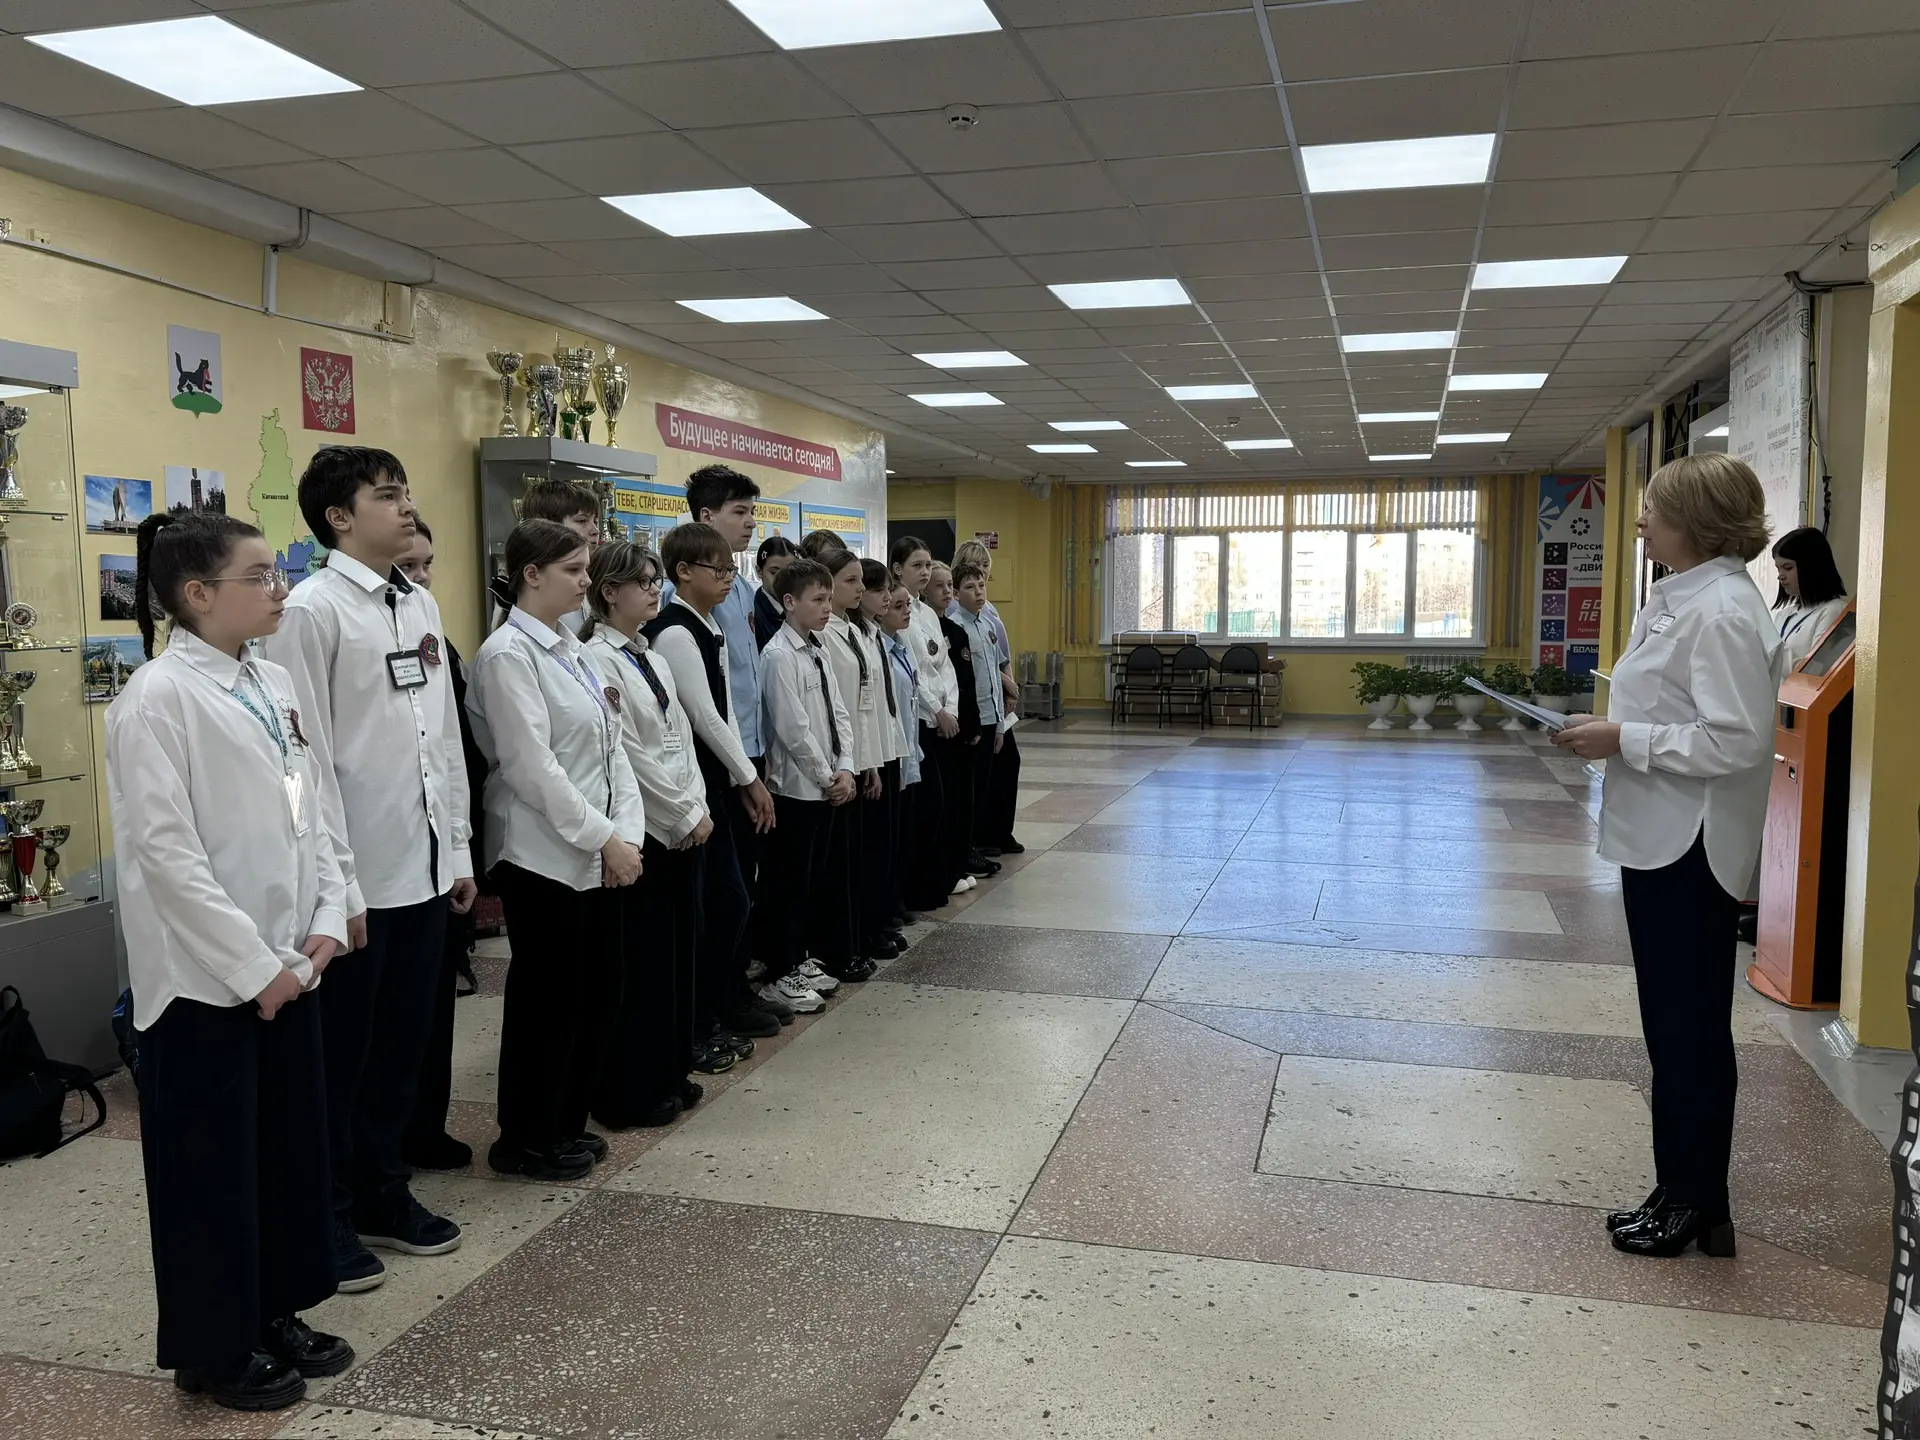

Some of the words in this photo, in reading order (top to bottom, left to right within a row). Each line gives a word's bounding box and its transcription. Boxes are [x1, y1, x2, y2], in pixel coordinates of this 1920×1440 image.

[669, 411, 728, 450] Будущее
[731, 433, 793, 463] начинается
[795, 448, 834, 473] сегодня!
[616, 492, 637, 510] ТЕБЕ,
[638, 494, 689, 514] СТАРШЕКЛАСС
[754, 504, 767, 519] НАЯ
[768, 506, 789, 521] ЖИЗНЬ
[1570, 542, 1604, 550] Росси
